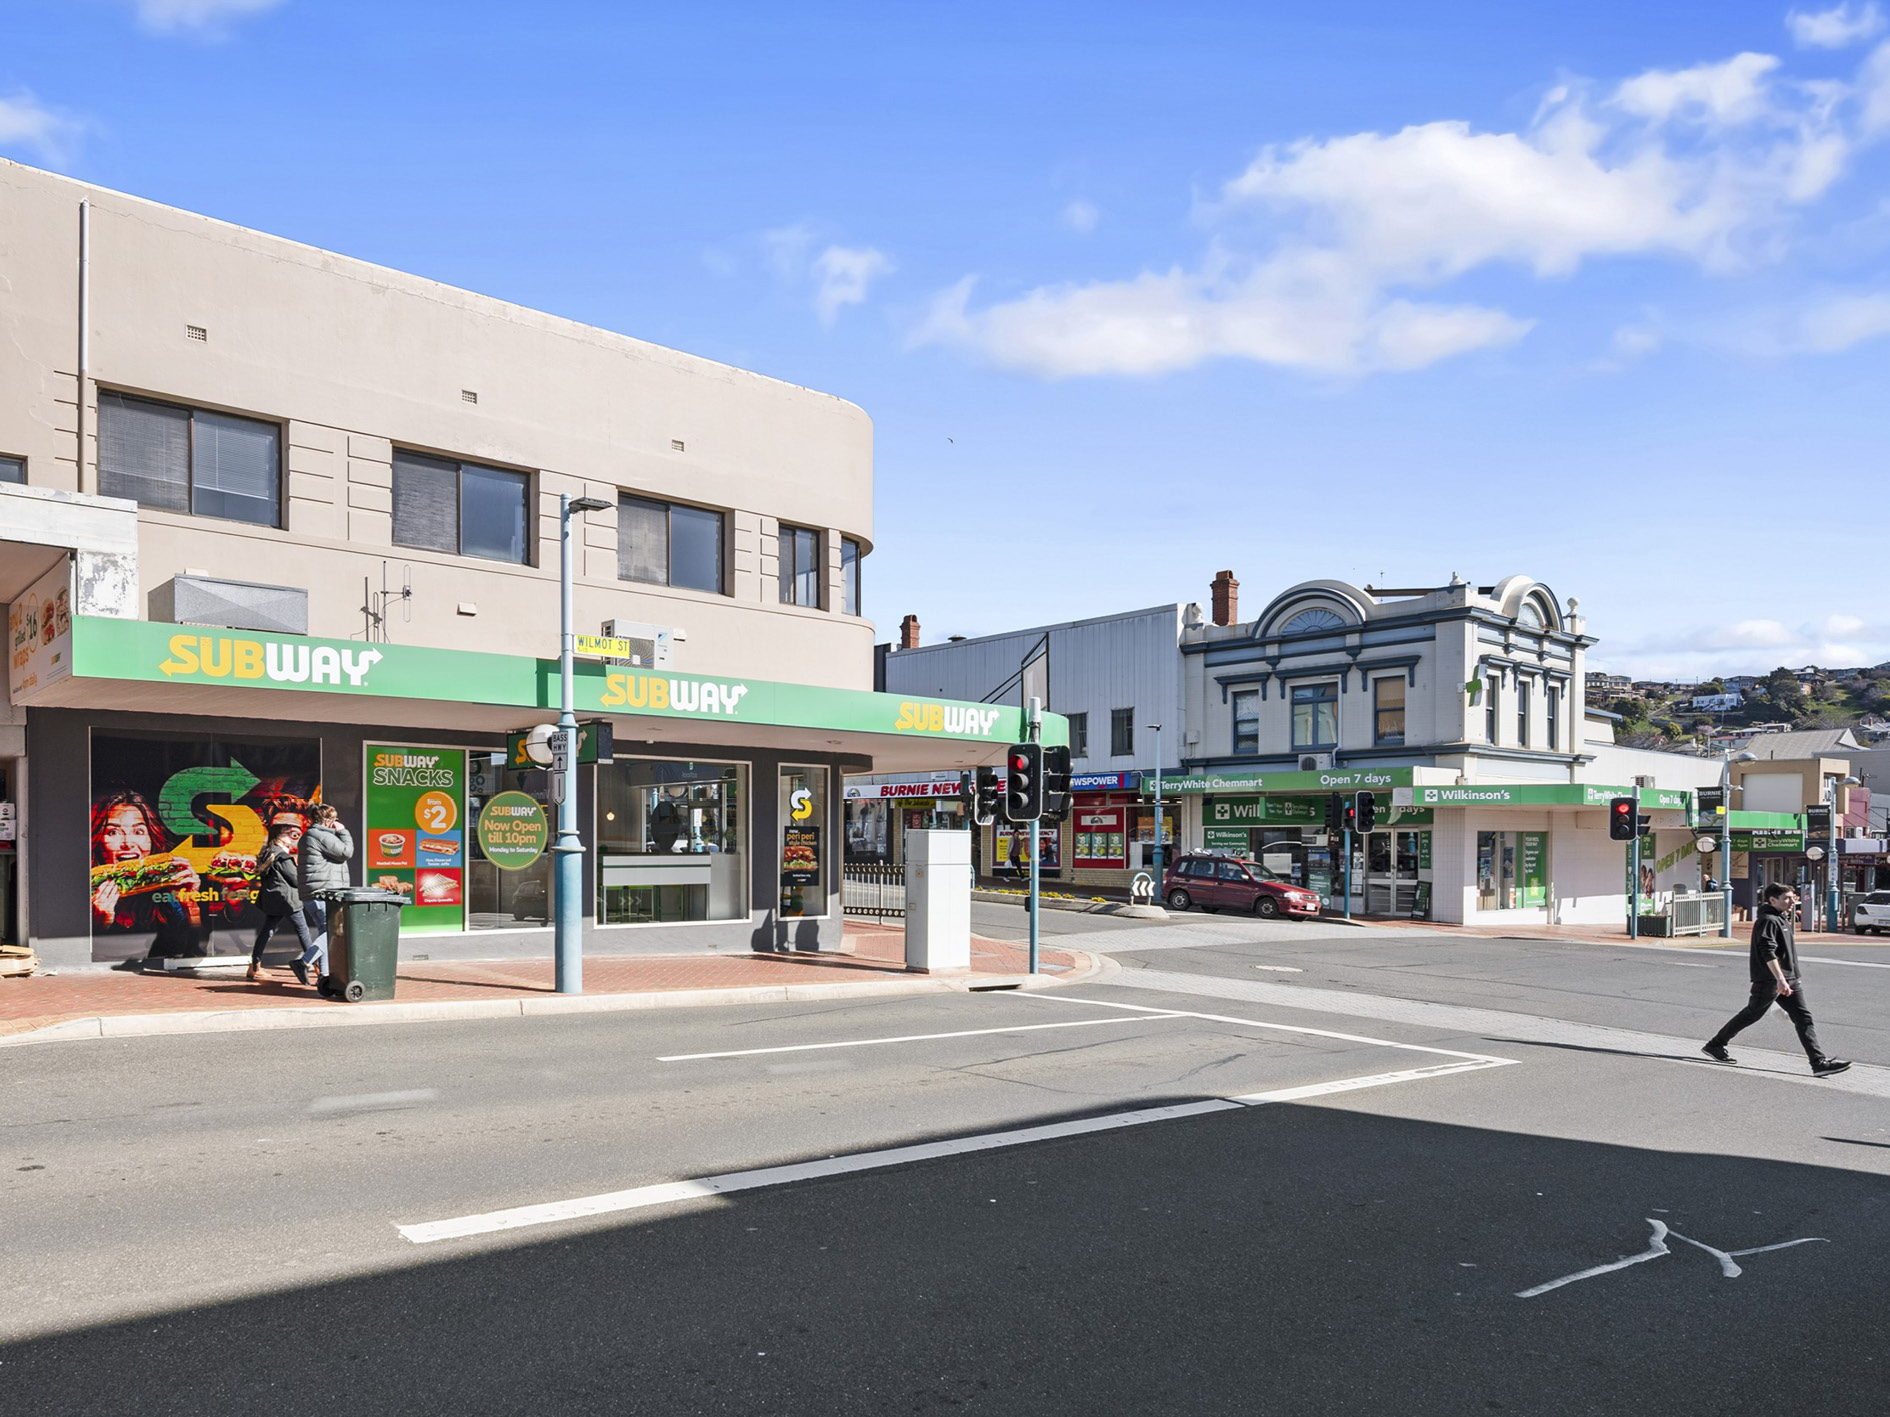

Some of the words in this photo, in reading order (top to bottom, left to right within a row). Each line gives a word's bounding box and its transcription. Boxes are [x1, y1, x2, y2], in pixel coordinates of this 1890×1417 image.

[578, 636, 612, 649] WILMOT
[618, 640, 628, 651] ST
[158, 634, 383, 686] SUBWAY
[600, 673, 748, 715] SUBWAY
[895, 701, 999, 735] SUBWAY
[553, 734, 568, 742] BASS
[374, 754, 439, 768] SUBWAY
[373, 767, 453, 787] SNACKS
[1320, 774, 1351, 786] Open
[1354, 774, 1361, 784] 7
[1364, 773, 1391, 785] days
[880, 784, 929, 797] BURNIE
[1161, 779, 1211, 792] TerryWhite
[1212, 778, 1263, 789] Chemmart
[1441, 790, 1511, 800] Wilkinson's
[424, 805, 446, 829] $2
[490, 806, 536, 816] SUBWAY
[484, 820, 510, 831] Now
[512, 820, 542, 834] Open
[1216, 830, 1247, 838] Wilkinson's
[488, 832, 503, 843] till
[505, 833, 537, 846] 10pm
[787, 832, 800, 841] peri
[801, 832, 814, 841] peri
[1656, 850, 1675, 874] OPEN
[1676, 848, 1680, 862] 7
[179, 888, 219, 902] fresh
